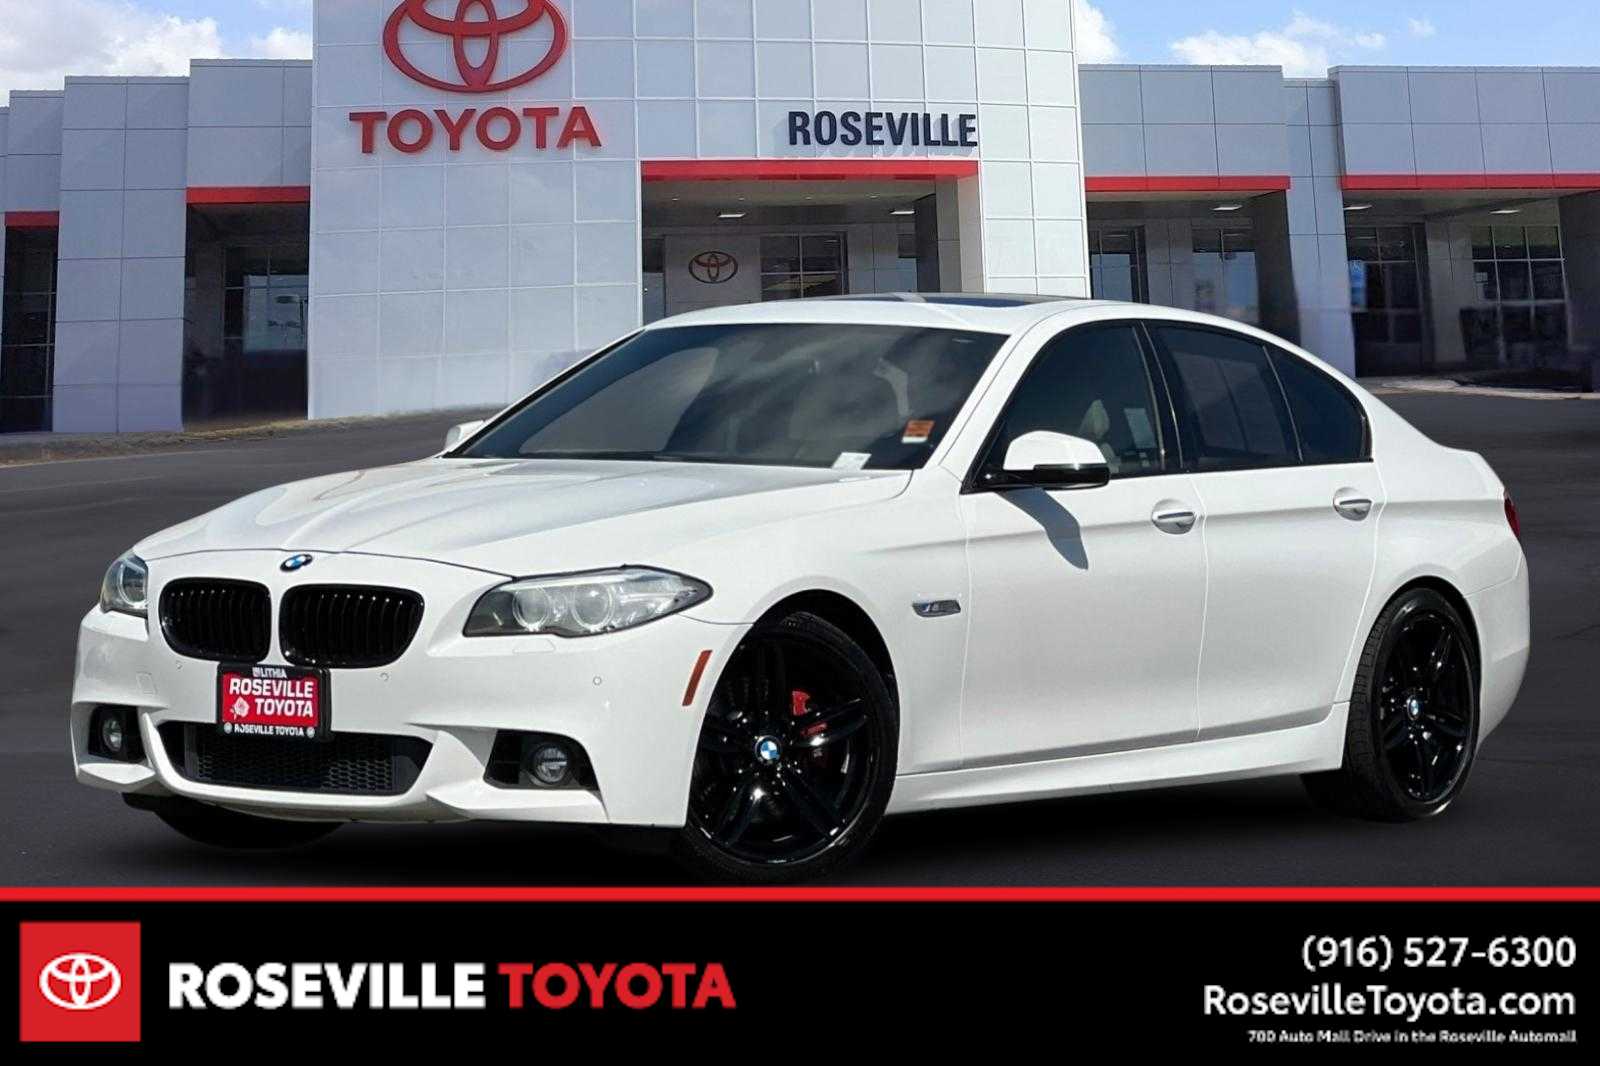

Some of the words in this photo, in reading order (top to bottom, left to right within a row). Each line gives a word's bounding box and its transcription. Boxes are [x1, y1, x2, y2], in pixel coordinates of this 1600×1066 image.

[349, 106, 602, 154] TOYOTA
[788, 111, 978, 147] ROSEVILLE
[229, 678, 314, 698] ROSEVILLE
[254, 698, 314, 718] TOYOTA
[234, 724, 274, 735] ROSEVILLE
[275, 726, 304, 737] TOYOTA
